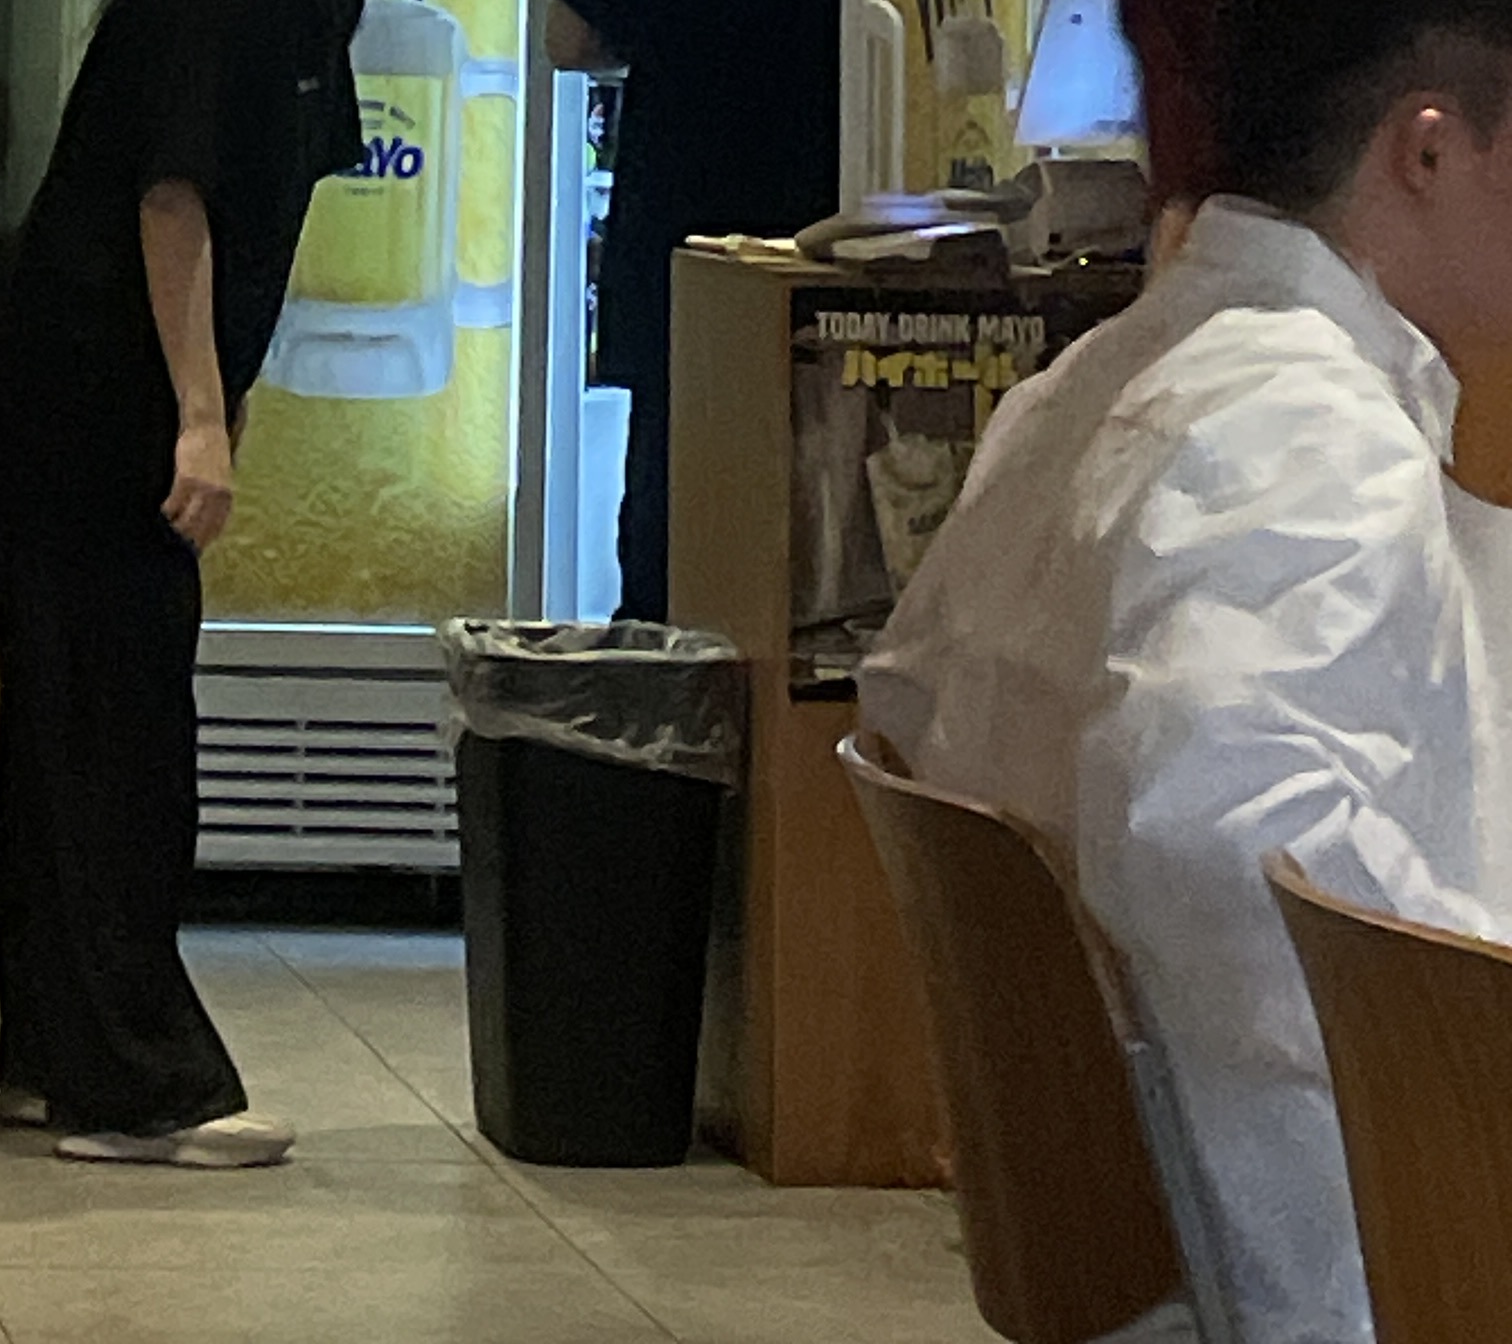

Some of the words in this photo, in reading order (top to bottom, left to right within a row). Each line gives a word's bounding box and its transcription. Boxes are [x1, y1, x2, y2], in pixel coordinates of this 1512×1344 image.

[816, 310, 890, 342] TODAY
[897, 312, 972, 344] DRINK
[977, 314, 1046, 344] MAYO
